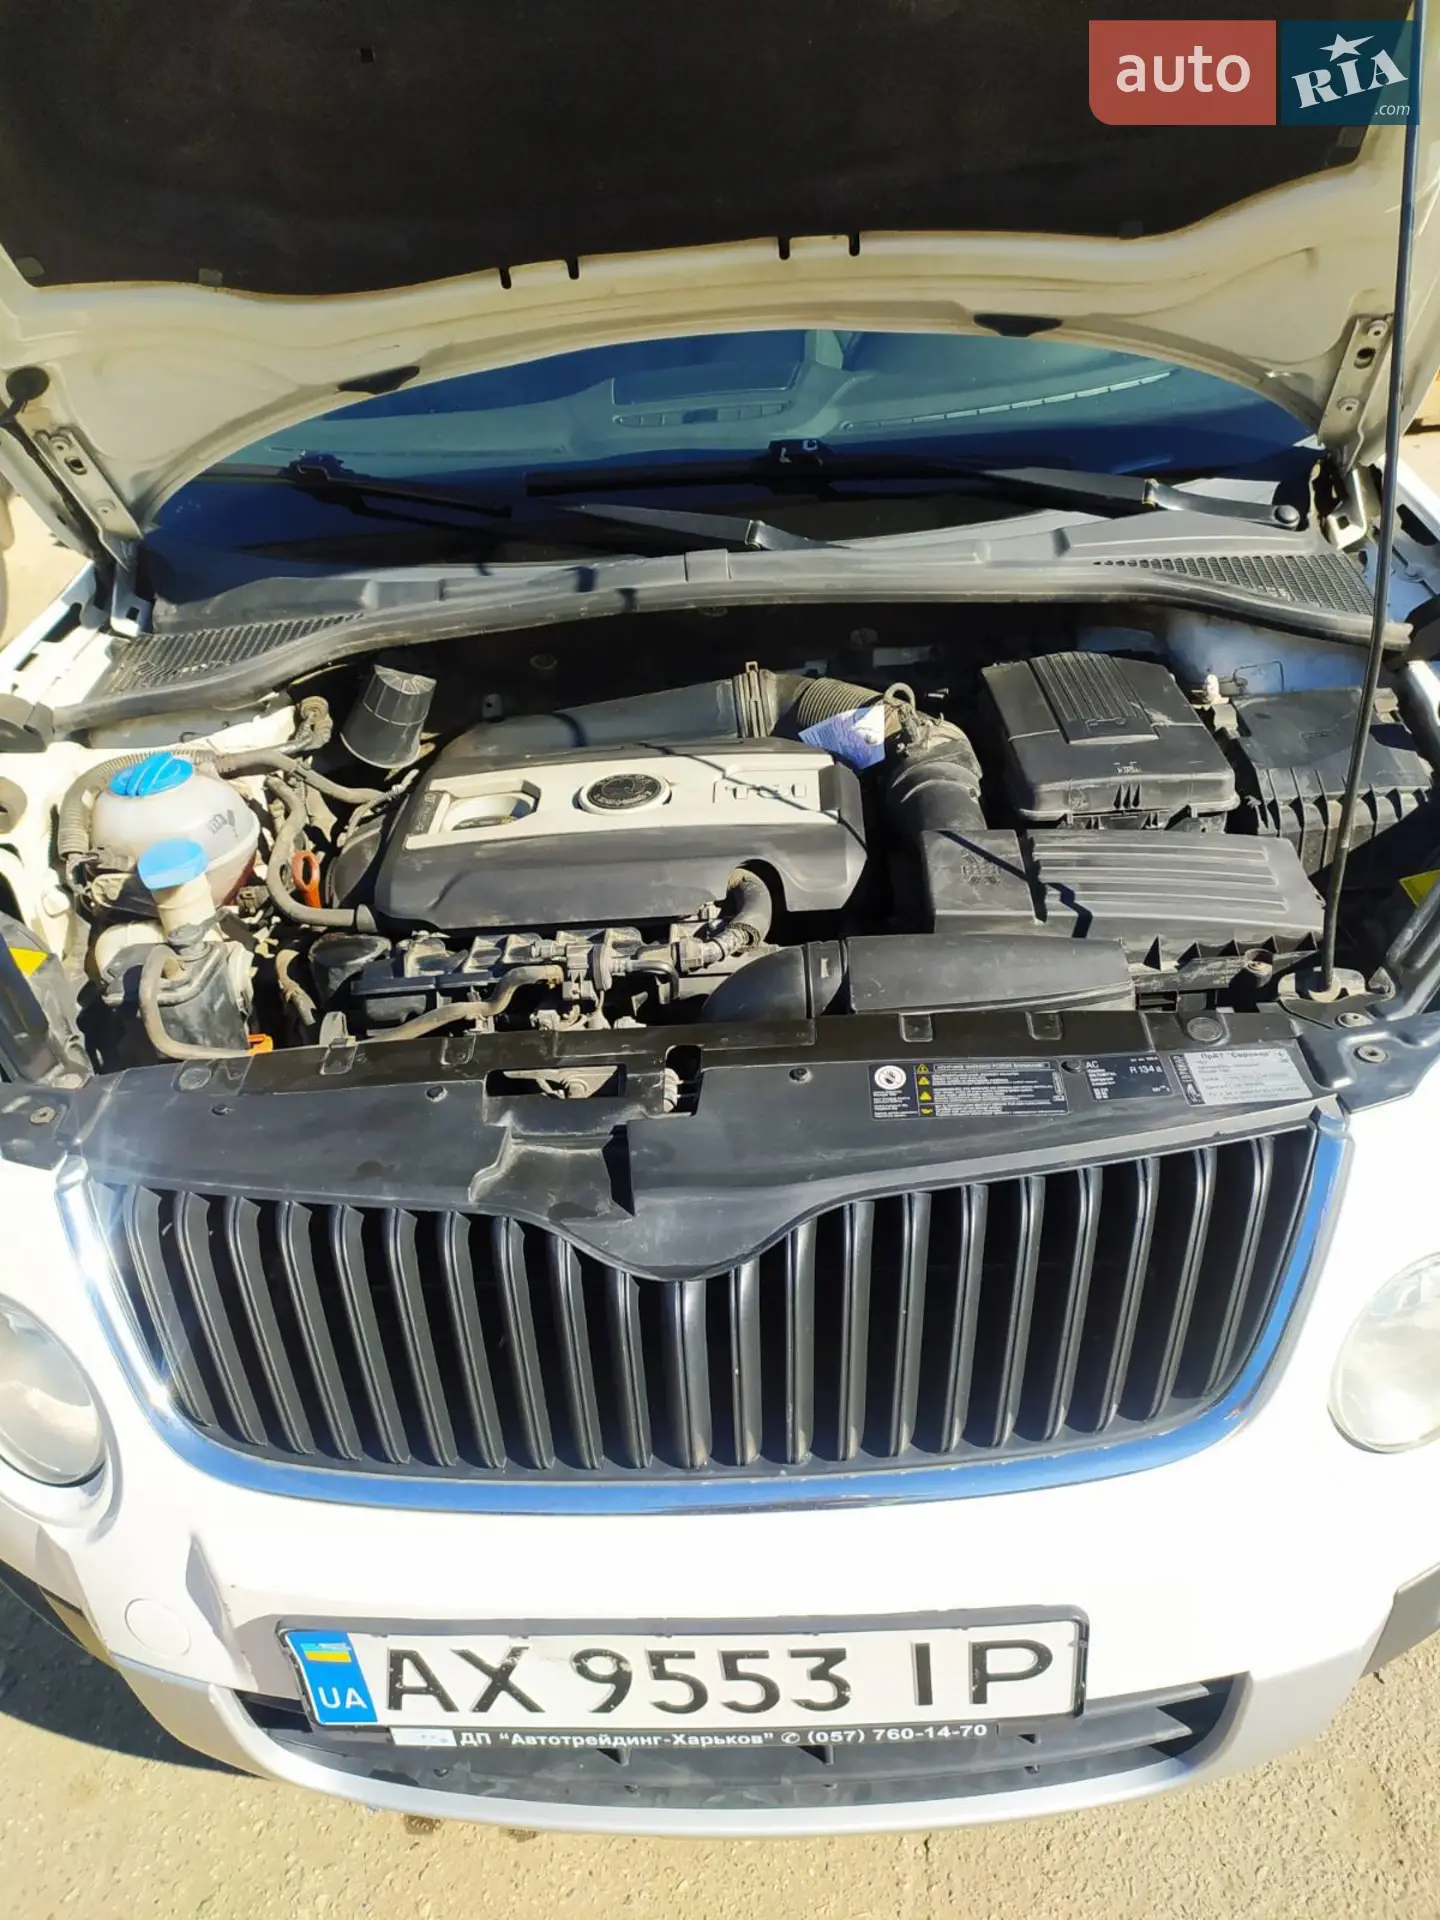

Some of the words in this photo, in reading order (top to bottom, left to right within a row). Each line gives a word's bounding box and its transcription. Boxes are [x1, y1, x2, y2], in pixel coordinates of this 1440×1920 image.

[1085, 1060, 1099, 1069] AC
[386, 1645, 546, 1714] AX
[570, 1647, 852, 1715] 9553
[911, 1639, 1053, 1706] IP
[317, 1687, 368, 1710] UA
[460, 1732, 492, 1746] ДП
[807, 1729, 866, 1744] (057)
[873, 1724, 987, 1742] 760-14-70
